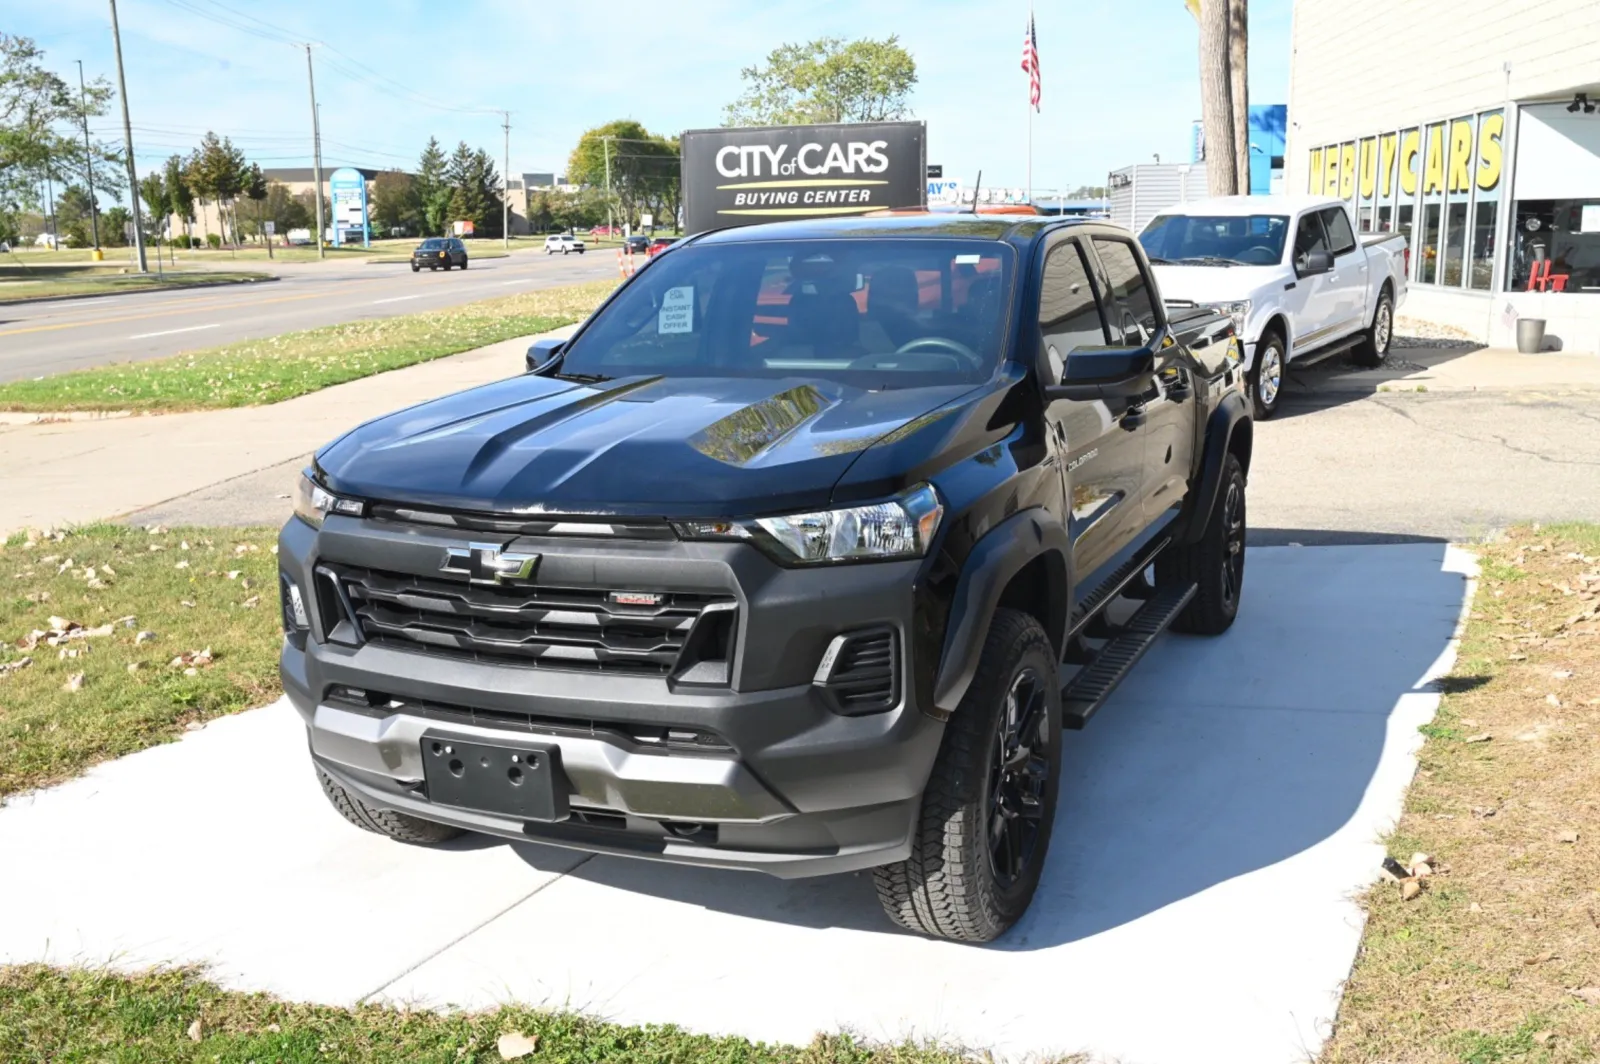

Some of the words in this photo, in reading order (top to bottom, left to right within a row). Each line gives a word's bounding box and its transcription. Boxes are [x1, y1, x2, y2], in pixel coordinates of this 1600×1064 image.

[715, 144, 788, 178] CITY
[780, 157, 798, 175] of
[797, 140, 889, 175] CARS
[1400, 114, 1504, 196] CARS
[735, 191, 799, 205] BUYING
[803, 189, 871, 203] CENTER
